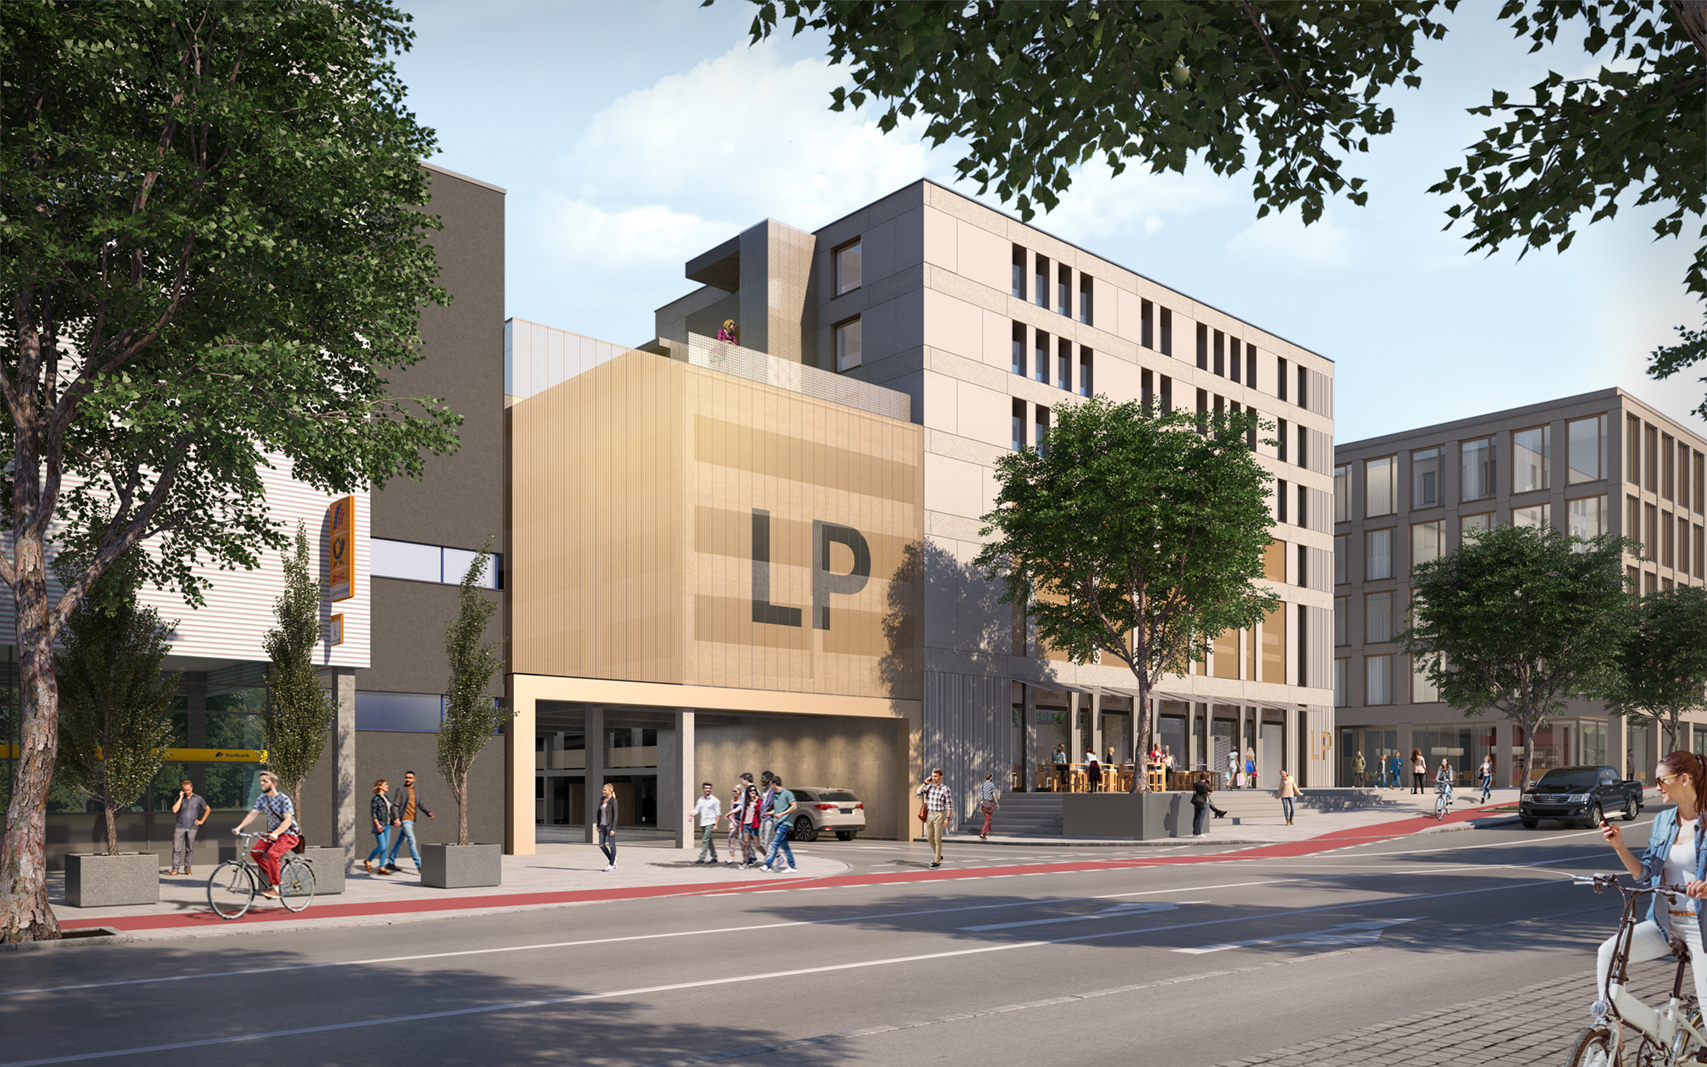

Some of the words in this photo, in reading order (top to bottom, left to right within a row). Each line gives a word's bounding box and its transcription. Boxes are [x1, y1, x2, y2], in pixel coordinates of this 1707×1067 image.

[751, 507, 872, 631] LP
[1041, 691, 1060, 700] coffee
[1311, 730, 1332, 761] LP
